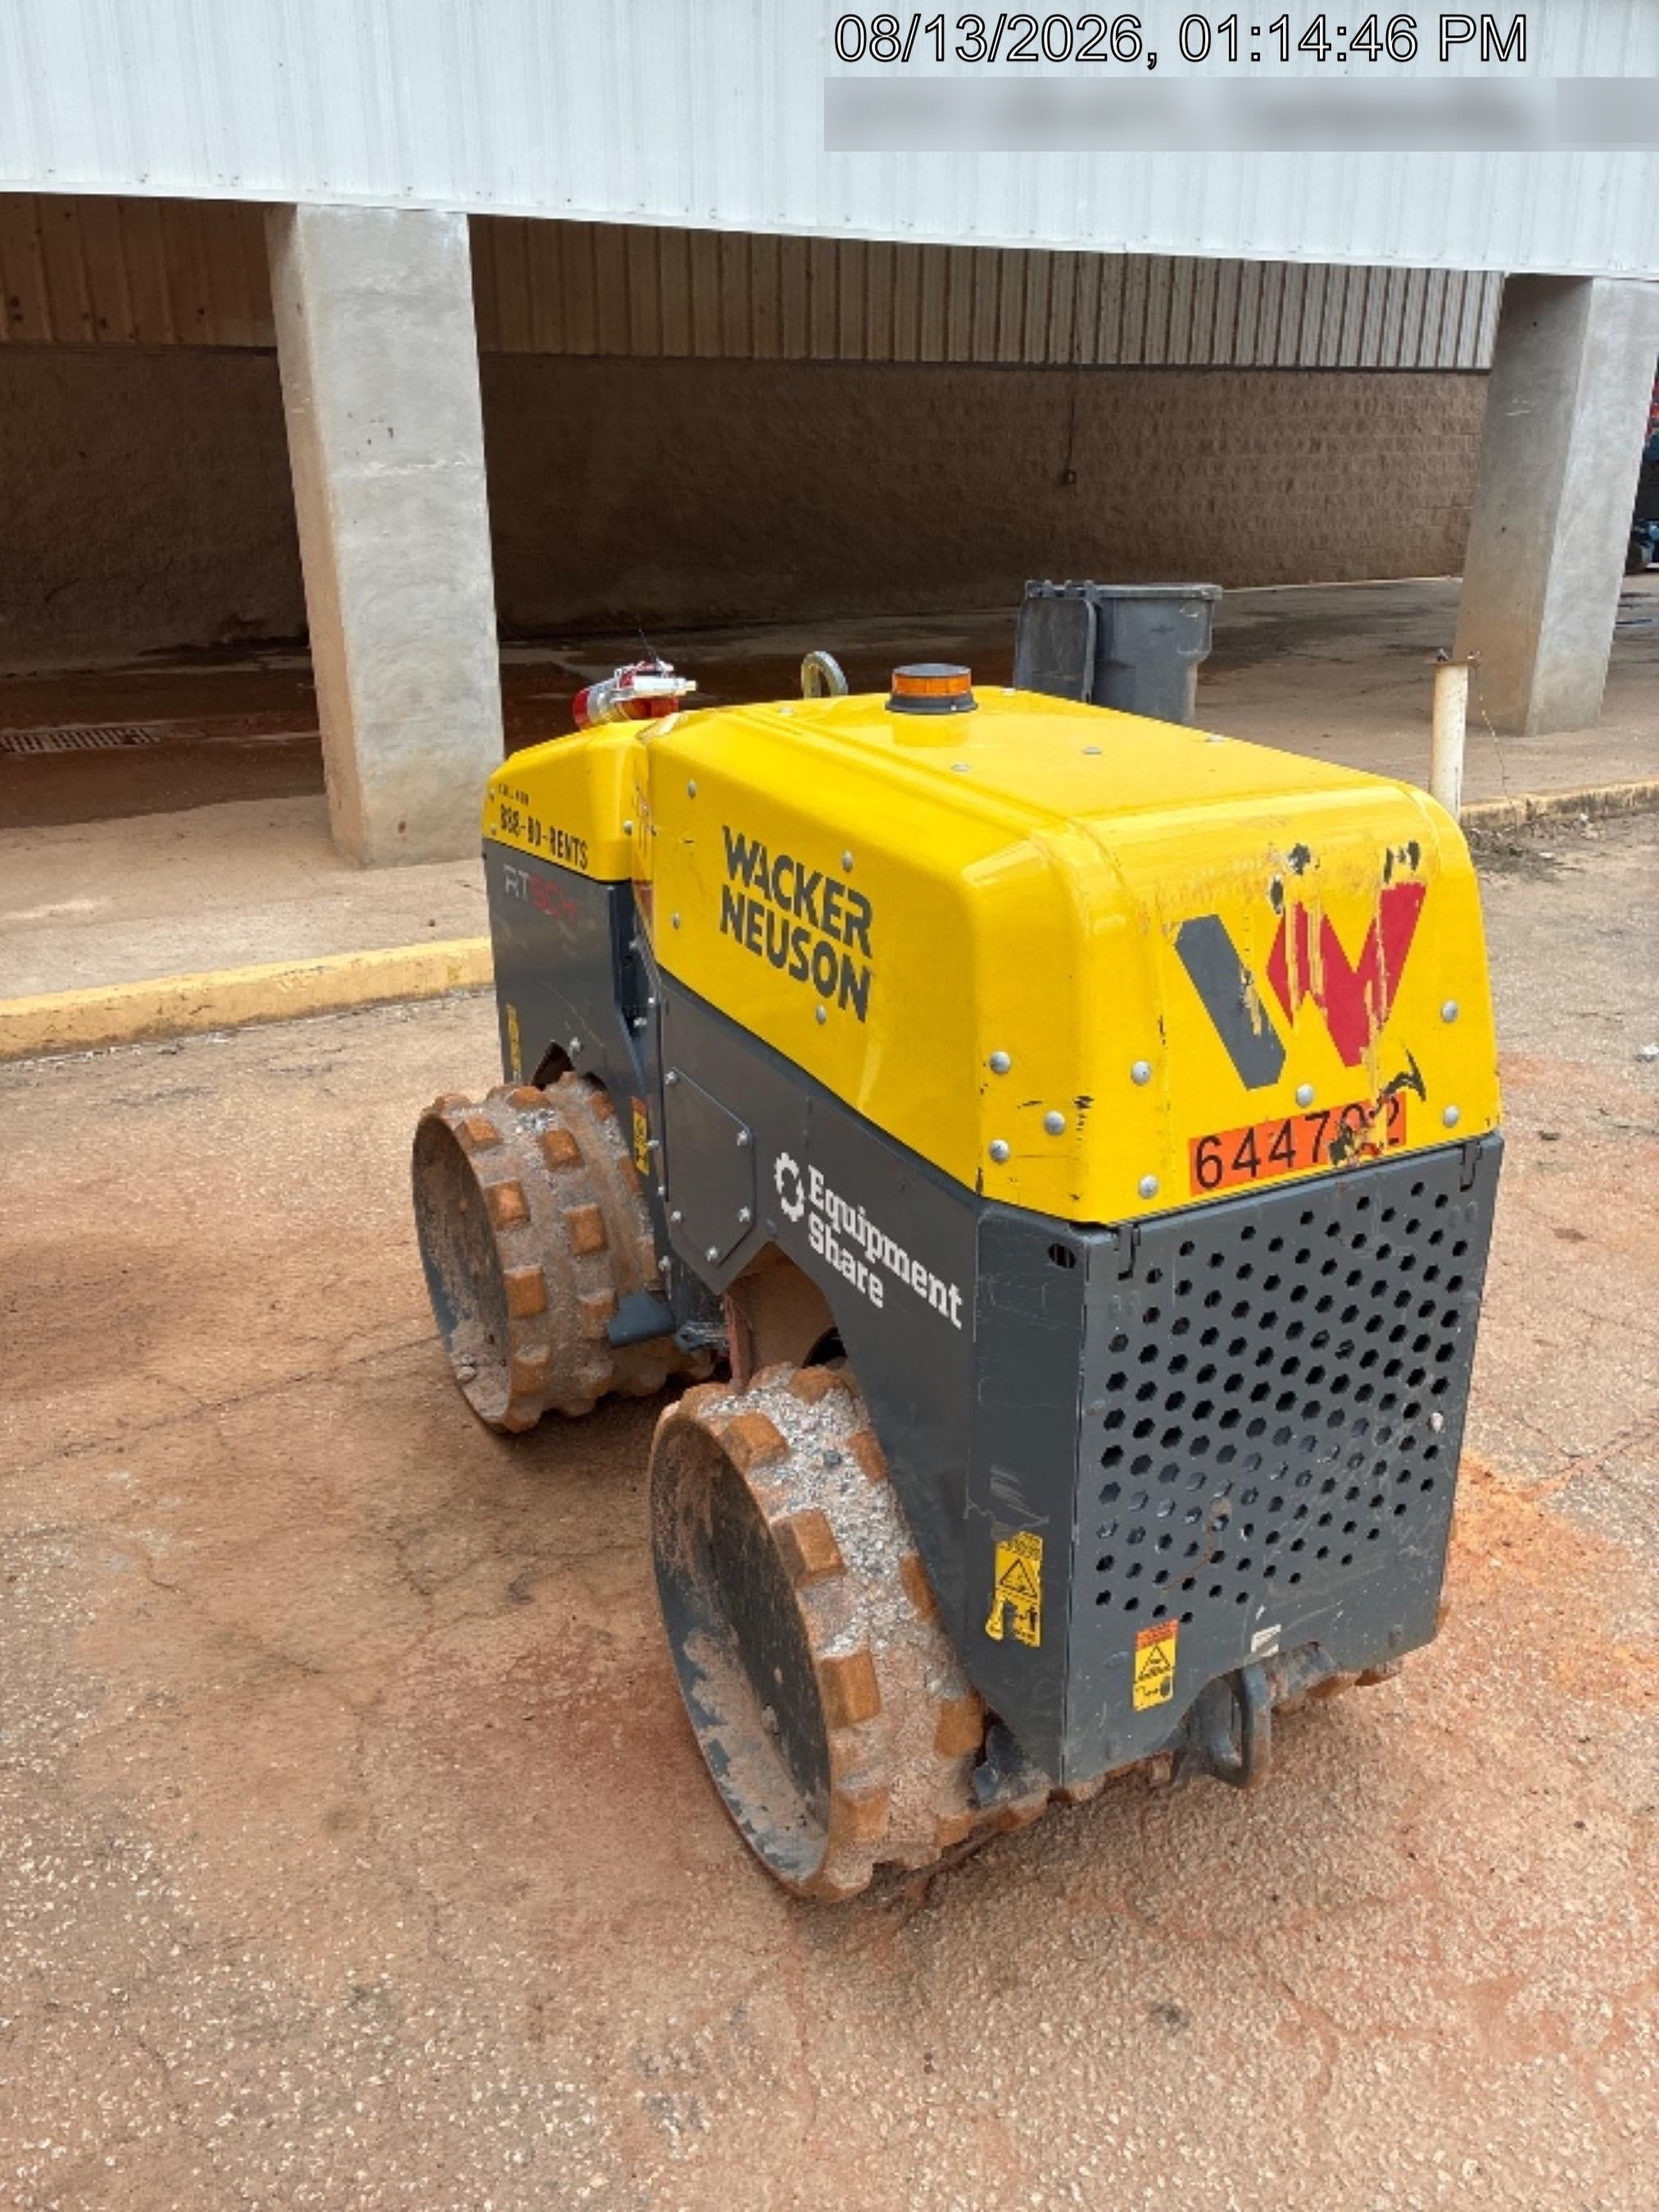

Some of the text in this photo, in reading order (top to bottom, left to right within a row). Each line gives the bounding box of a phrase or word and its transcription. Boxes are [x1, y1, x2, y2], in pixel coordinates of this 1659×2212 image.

[720, 884, 872, 1022] NEUSON
[722, 825, 873, 959] WACKER
[808, 1164, 963, 1330] Equipment
[808, 1211, 884, 1308] Share
